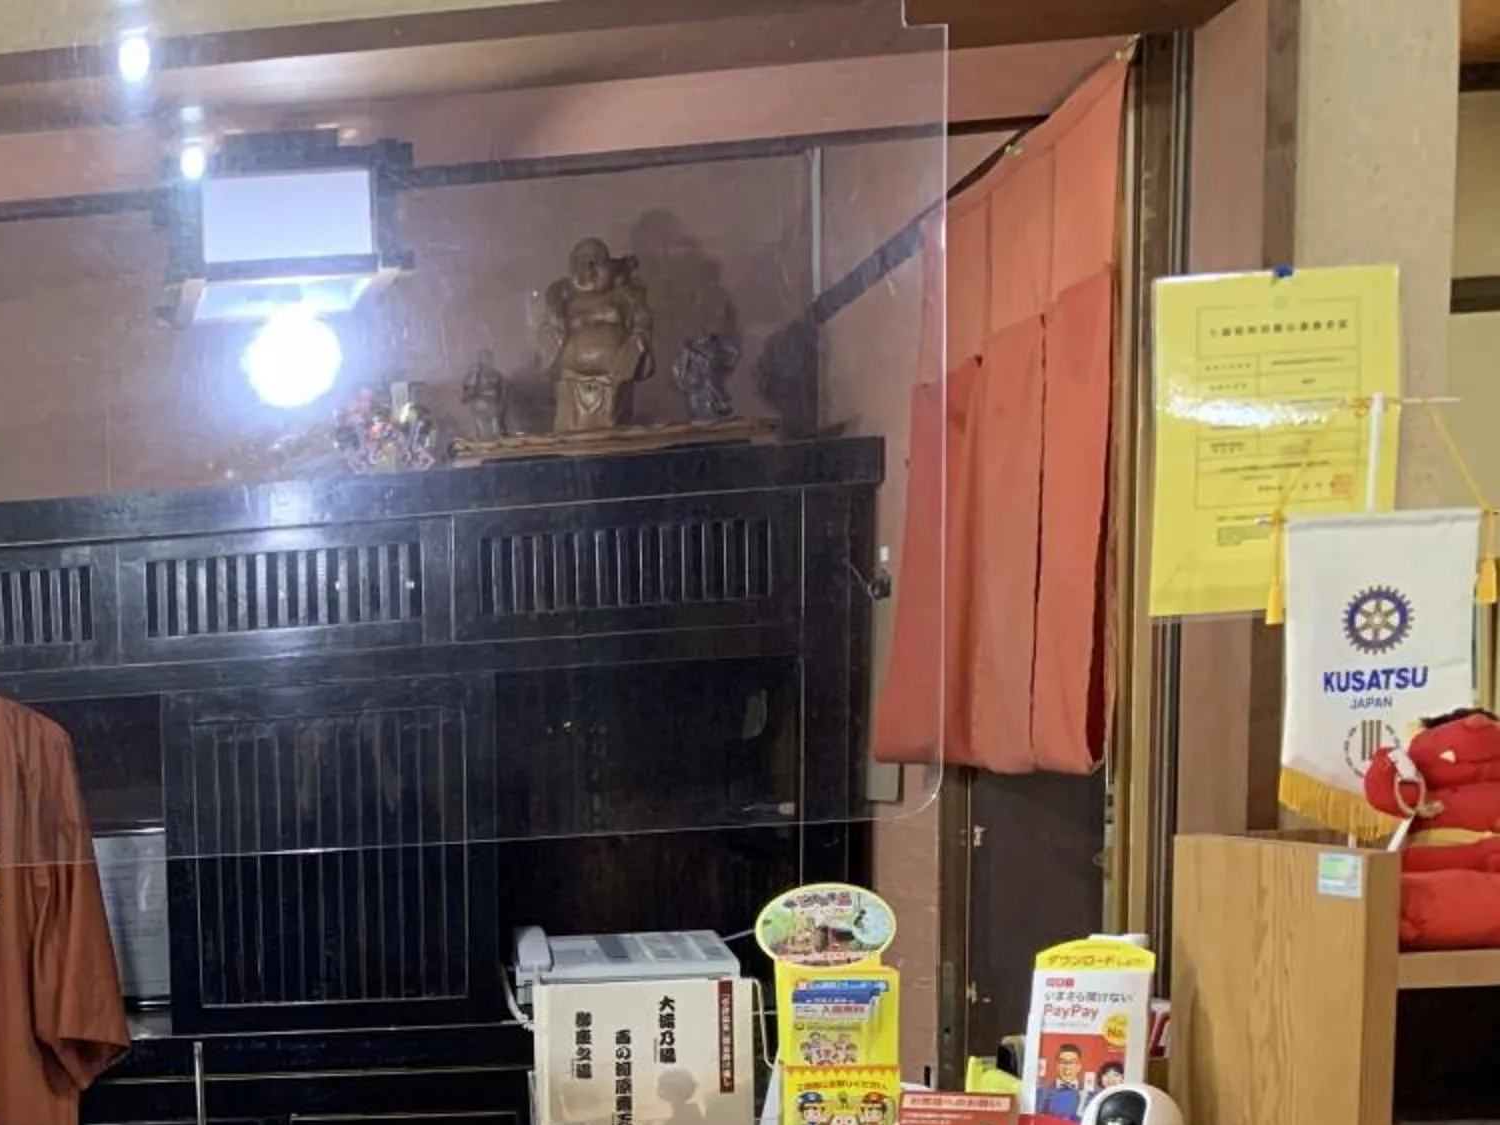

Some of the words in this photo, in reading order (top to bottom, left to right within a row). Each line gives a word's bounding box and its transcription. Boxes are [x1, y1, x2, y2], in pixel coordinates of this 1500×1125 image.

[1323, 666, 1428, 693] KUSATSU
[1350, 697, 1393, 709] JAPAN
[1044, 1004, 1098, 1019] PayPay
